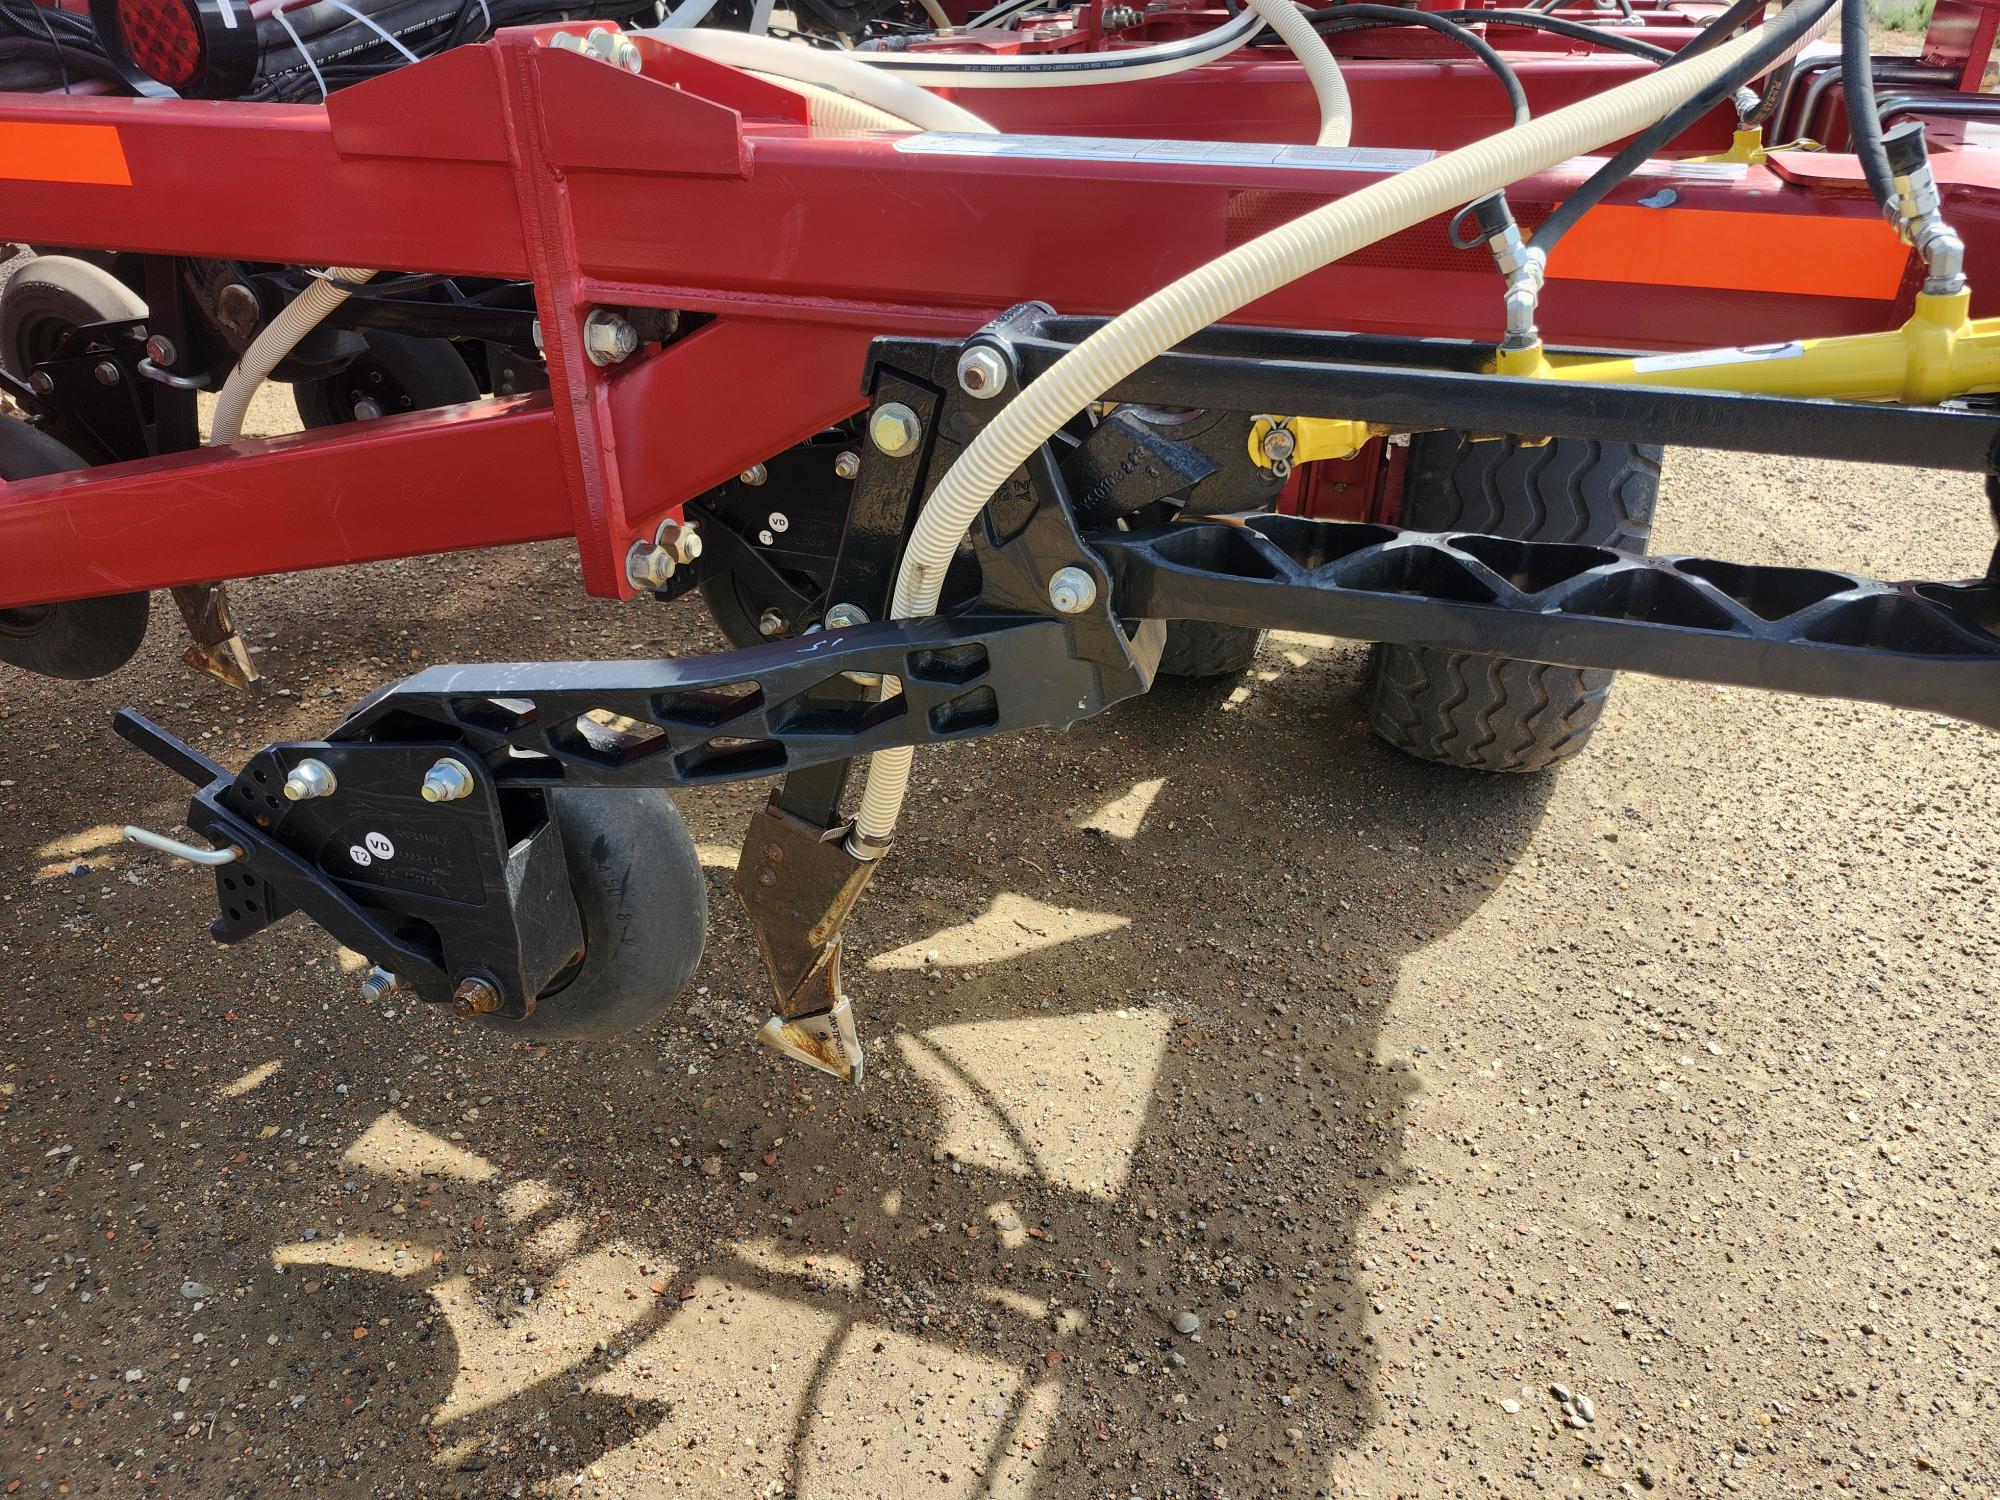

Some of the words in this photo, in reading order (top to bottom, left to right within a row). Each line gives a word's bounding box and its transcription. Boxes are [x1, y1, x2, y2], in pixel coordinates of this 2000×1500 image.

[772, 518, 786, 526] VD
[369, 839, 391, 852] VD
[351, 850, 371, 863] T2
